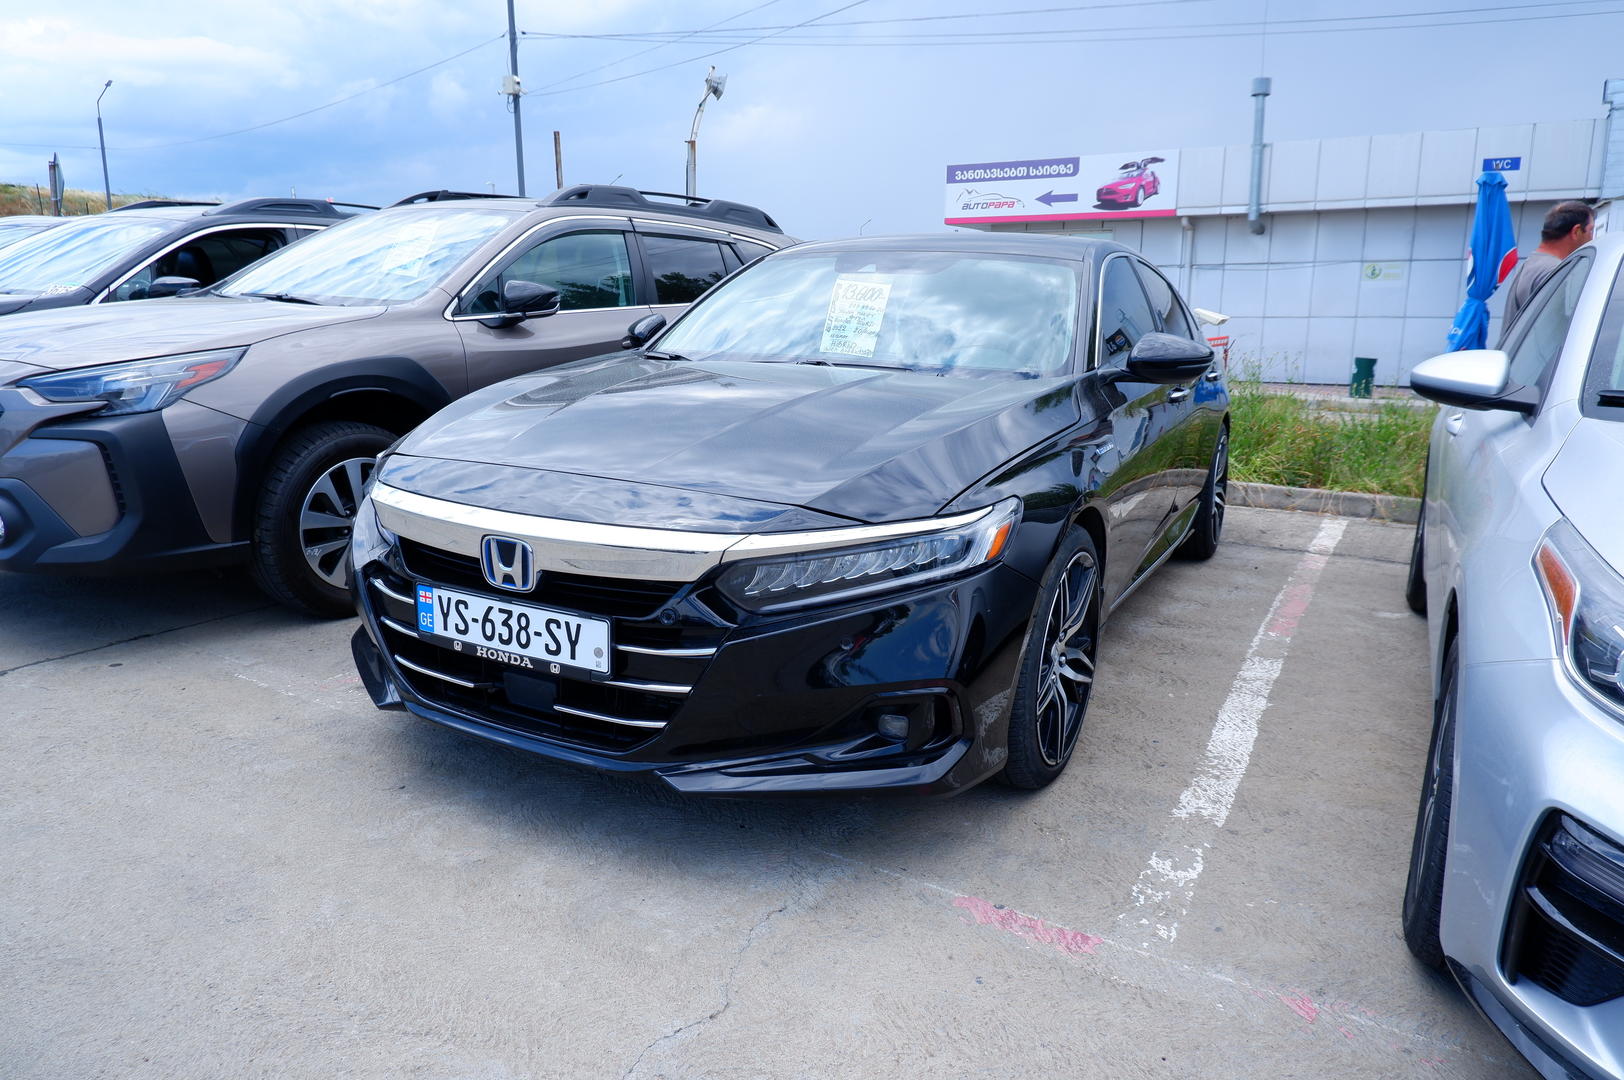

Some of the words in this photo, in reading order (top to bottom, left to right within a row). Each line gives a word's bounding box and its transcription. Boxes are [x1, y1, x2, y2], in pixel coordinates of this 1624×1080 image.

[1029, 163, 1073, 175] საიტზე
[1492, 159, 1512, 169] WC
[419, 611, 433, 628] GE
[437, 594, 582, 660] YS-638-SY
[476, 645, 534, 669] HONDA
